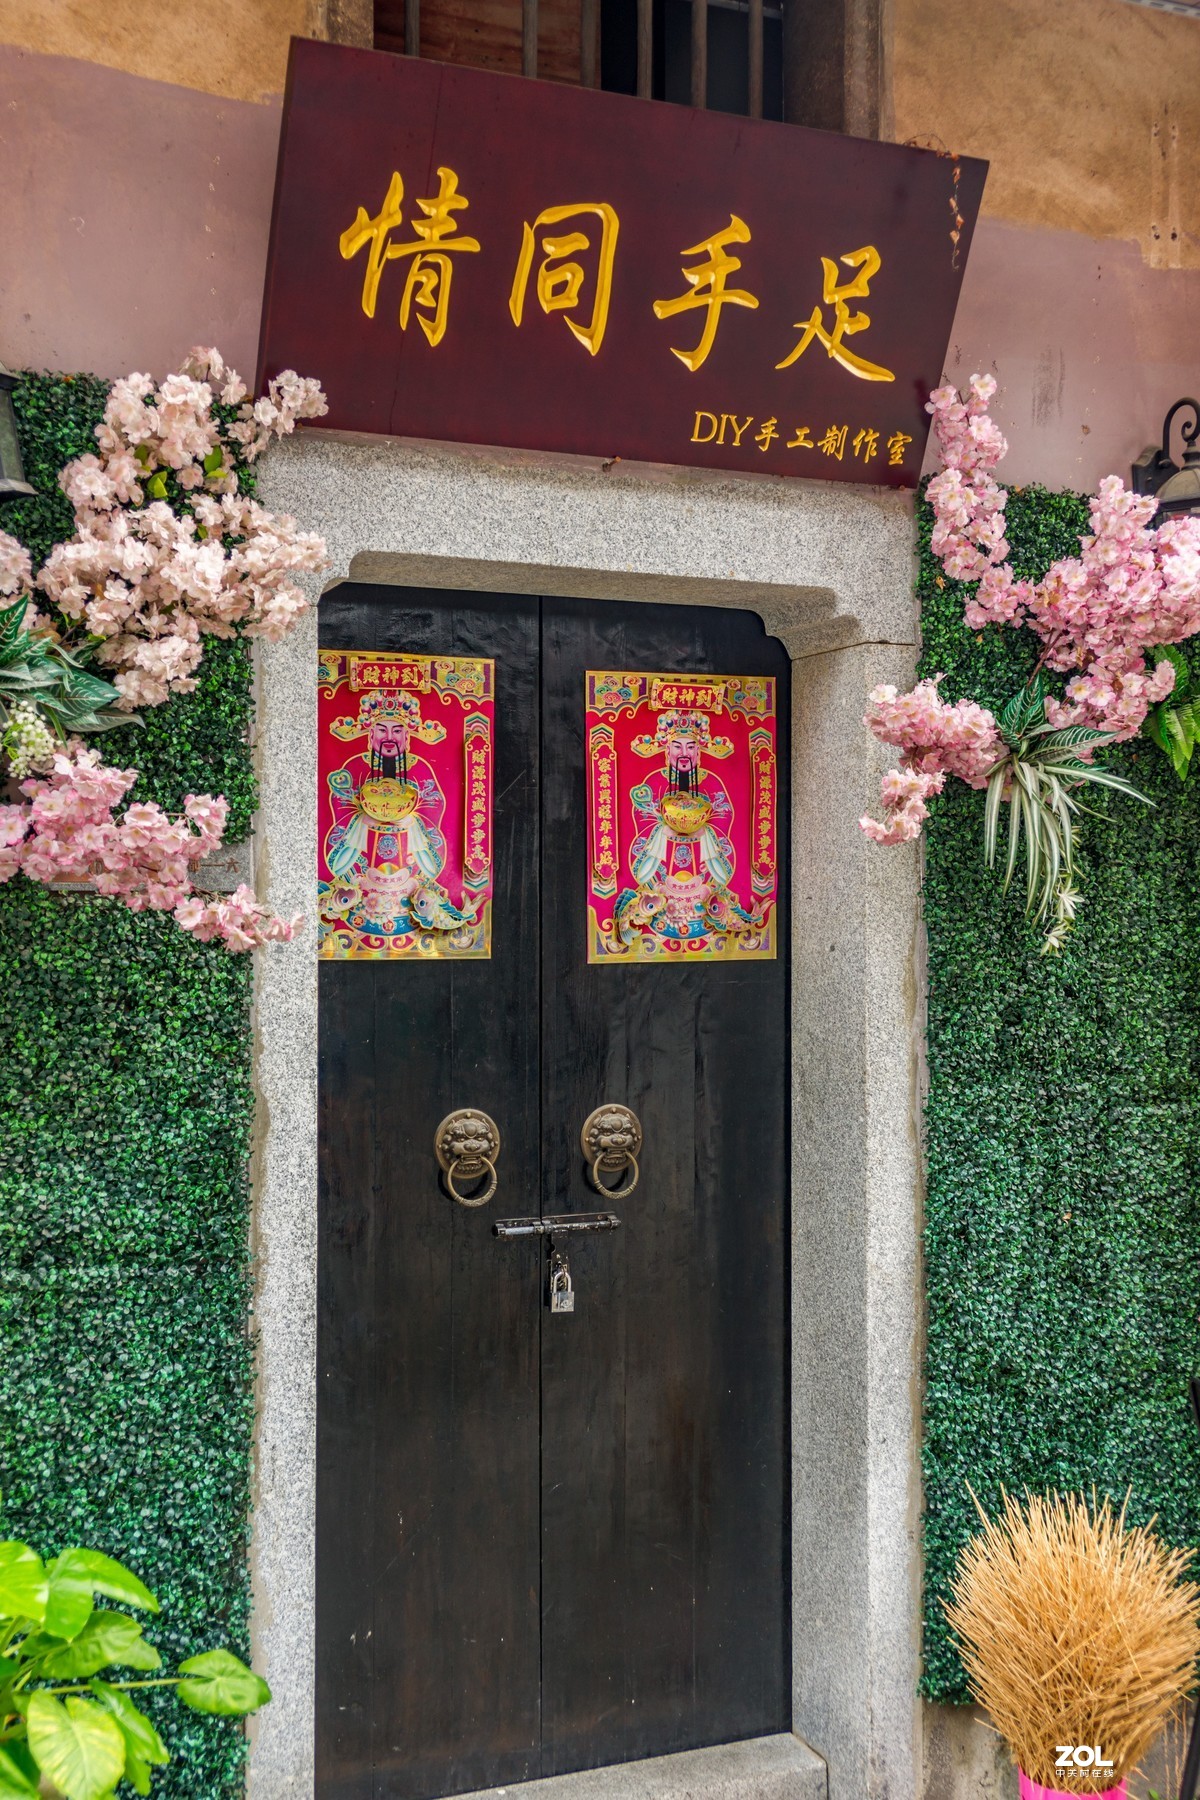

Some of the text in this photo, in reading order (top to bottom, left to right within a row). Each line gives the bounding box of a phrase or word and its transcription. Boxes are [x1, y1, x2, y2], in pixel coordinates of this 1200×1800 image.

[339, 167, 895, 382] 情同手足
[363, 665, 419, 686] 財神到
[661, 687, 712, 708] 財神到
